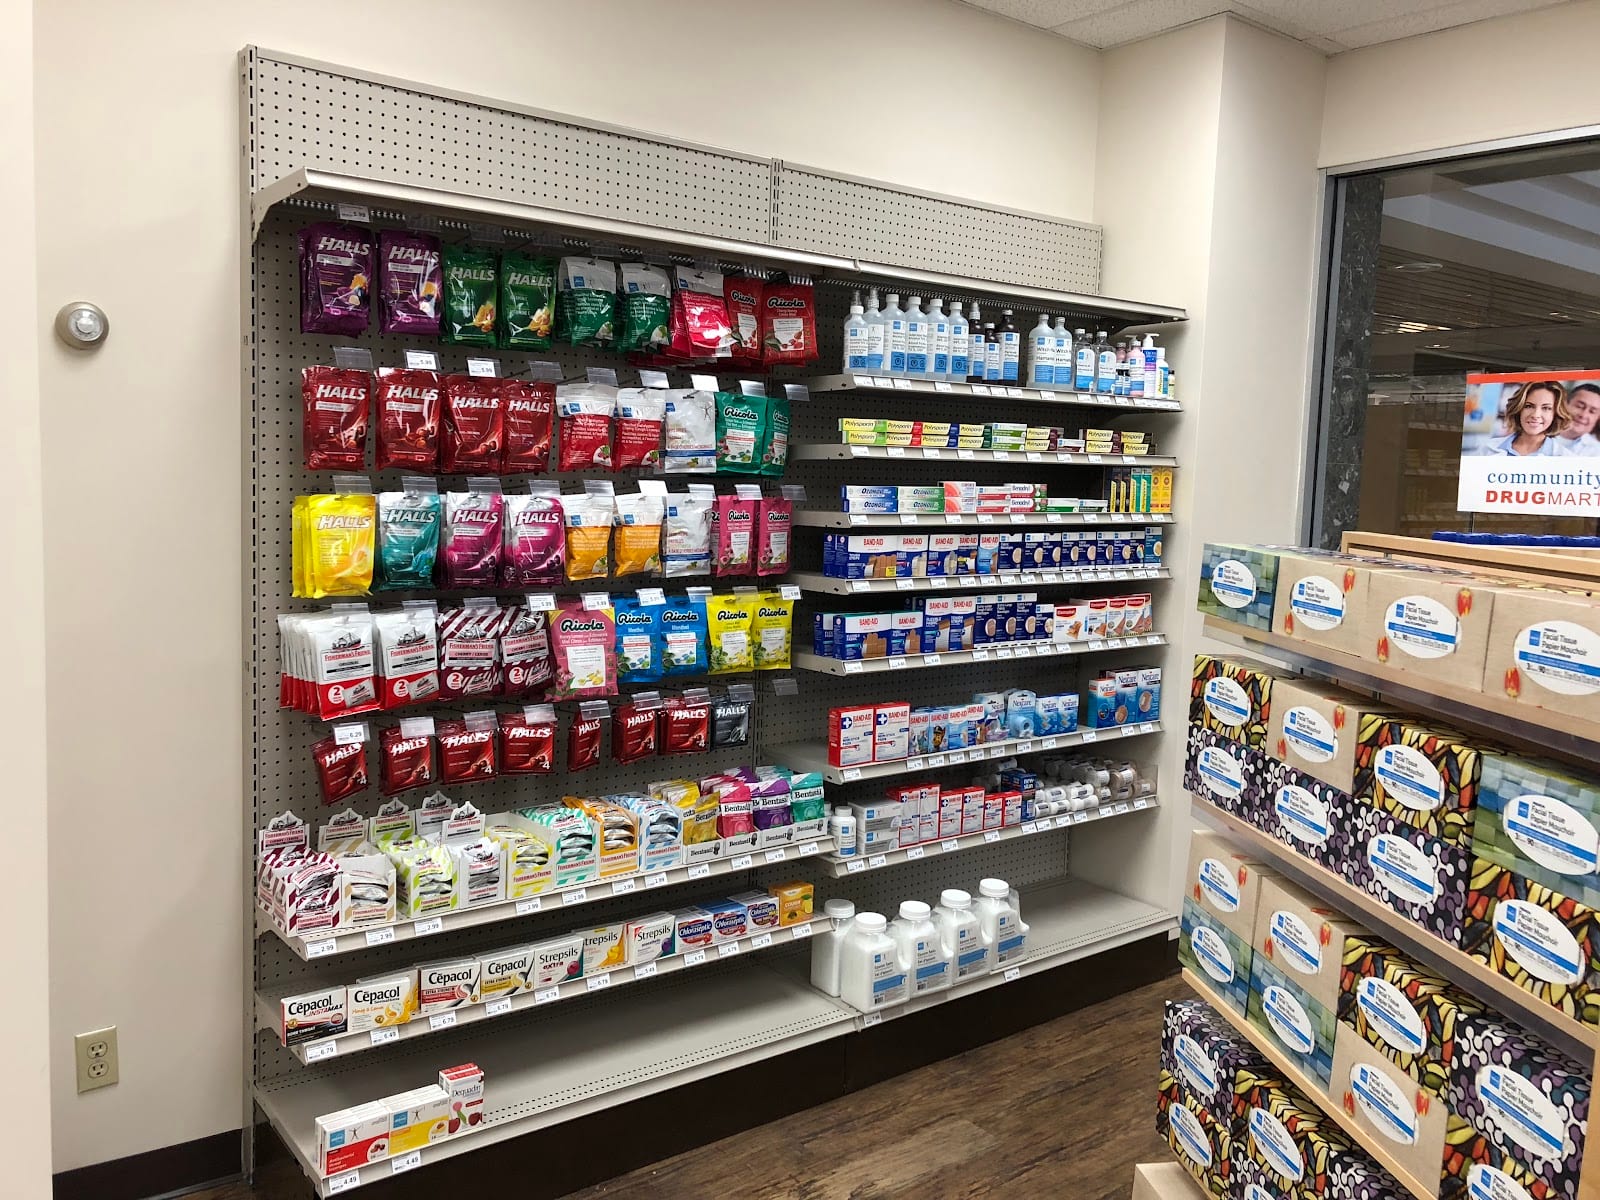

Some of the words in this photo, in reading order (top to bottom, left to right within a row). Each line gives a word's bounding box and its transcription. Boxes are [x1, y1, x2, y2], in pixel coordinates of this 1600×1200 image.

[318, 236, 370, 256] HALLS
[388, 246, 439, 262] HALLS
[451, 267, 495, 281] HALLS
[508, 272, 552, 287] HALLS
[768, 297, 805, 308] Ricola
[316, 384, 366, 400] HALLS
[387, 385, 438, 400] HALLS
[452, 396, 499, 409] HALLS
[508, 400, 550, 413] HALLS
[724, 405, 758, 420] Ricola
[1487, 470, 1600, 489] community
[1485, 490, 1600, 506] DRUGMART
[387, 509, 436, 523] HALLS
[454, 510, 498, 523] HALLS
[517, 512, 560, 524] HALLS
[728, 510, 750, 521] Ricola
[768, 512, 789, 523] Ricola
[318, 515, 371, 530] HALLS
[618, 613, 651, 624] Ricola
[662, 611, 698, 622] Ricola
[717, 610, 748, 620] Ricola
[758, 608, 788, 617] Ricola
[561, 619, 604, 632] Ricola
[1419, 616, 1439, 624] Mouchoir
[504, 636, 530, 646] FISHERMAN'S
[1543, 632, 1558, 641] Facial
[1560, 635, 1577, 644] Tissue
[391, 646, 418, 657] FISHERMAN'S
[1542, 641, 1560, 650] Papier
[1560, 645, 1587, 656] Mouchoir
[325, 652, 354, 661] FISHERMAN'S
[515, 668, 521, 677] 2
[398, 681, 405, 689] 2
[1118, 675, 1137, 684] Nexcare
[333, 687, 340, 695] 2
[1100, 684, 1115, 692] Nexcare
[1013, 699, 1031, 707] Nexcare
[673, 708, 707, 720] HALLS
[717, 706, 746, 718] HALLS
[627, 711, 654, 728] HALLS
[509, 727, 553, 738] HALLS
[578, 719, 600, 736] HALLS
[447, 731, 490, 748] HALLS
[391, 738, 428, 756] HALLS
[325, 742, 362, 767] HALLS
[794, 789, 822, 799] Bentasil
[724, 803, 751, 812] Bentasil
[762, 796, 789, 806] Bentasil
[1532, 806, 1547, 817] Facial
[1549, 812, 1565, 824] Tissue
[1530, 815, 1547, 827] Papier
[1549, 820, 1575, 837] Mouchoir
[729, 838, 750, 846] Bentasil
[765, 833, 786, 841] Bentasil
[690, 847, 713, 856] Bentasil
[715, 914, 746, 929] Chloraseptic
[1519, 909, 1533, 923] Facial
[1534, 916, 1549, 932] Tissue
[637, 925, 671, 941] Strepsils
[679, 921, 712, 937] Chloraseptic
[1518, 918, 1532, 932] Papier
[1534, 925, 1559, 945] Mouchoir
[583, 932, 618, 946] trepsils
[539, 948, 578, 963] Strepsils
[321, 1047, 334, 1055] 6.79
[1503, 1075, 1517, 1089] Facial
[1518, 1084, 1534, 1104] Tissue
[1501, 1085, 1515, 1099] Papier
[1516, 1095, 1543, 1119] Mouchoir
[406, 1157, 418, 1165] 4.49
[344, 1176, 357, 1185] 4.49
